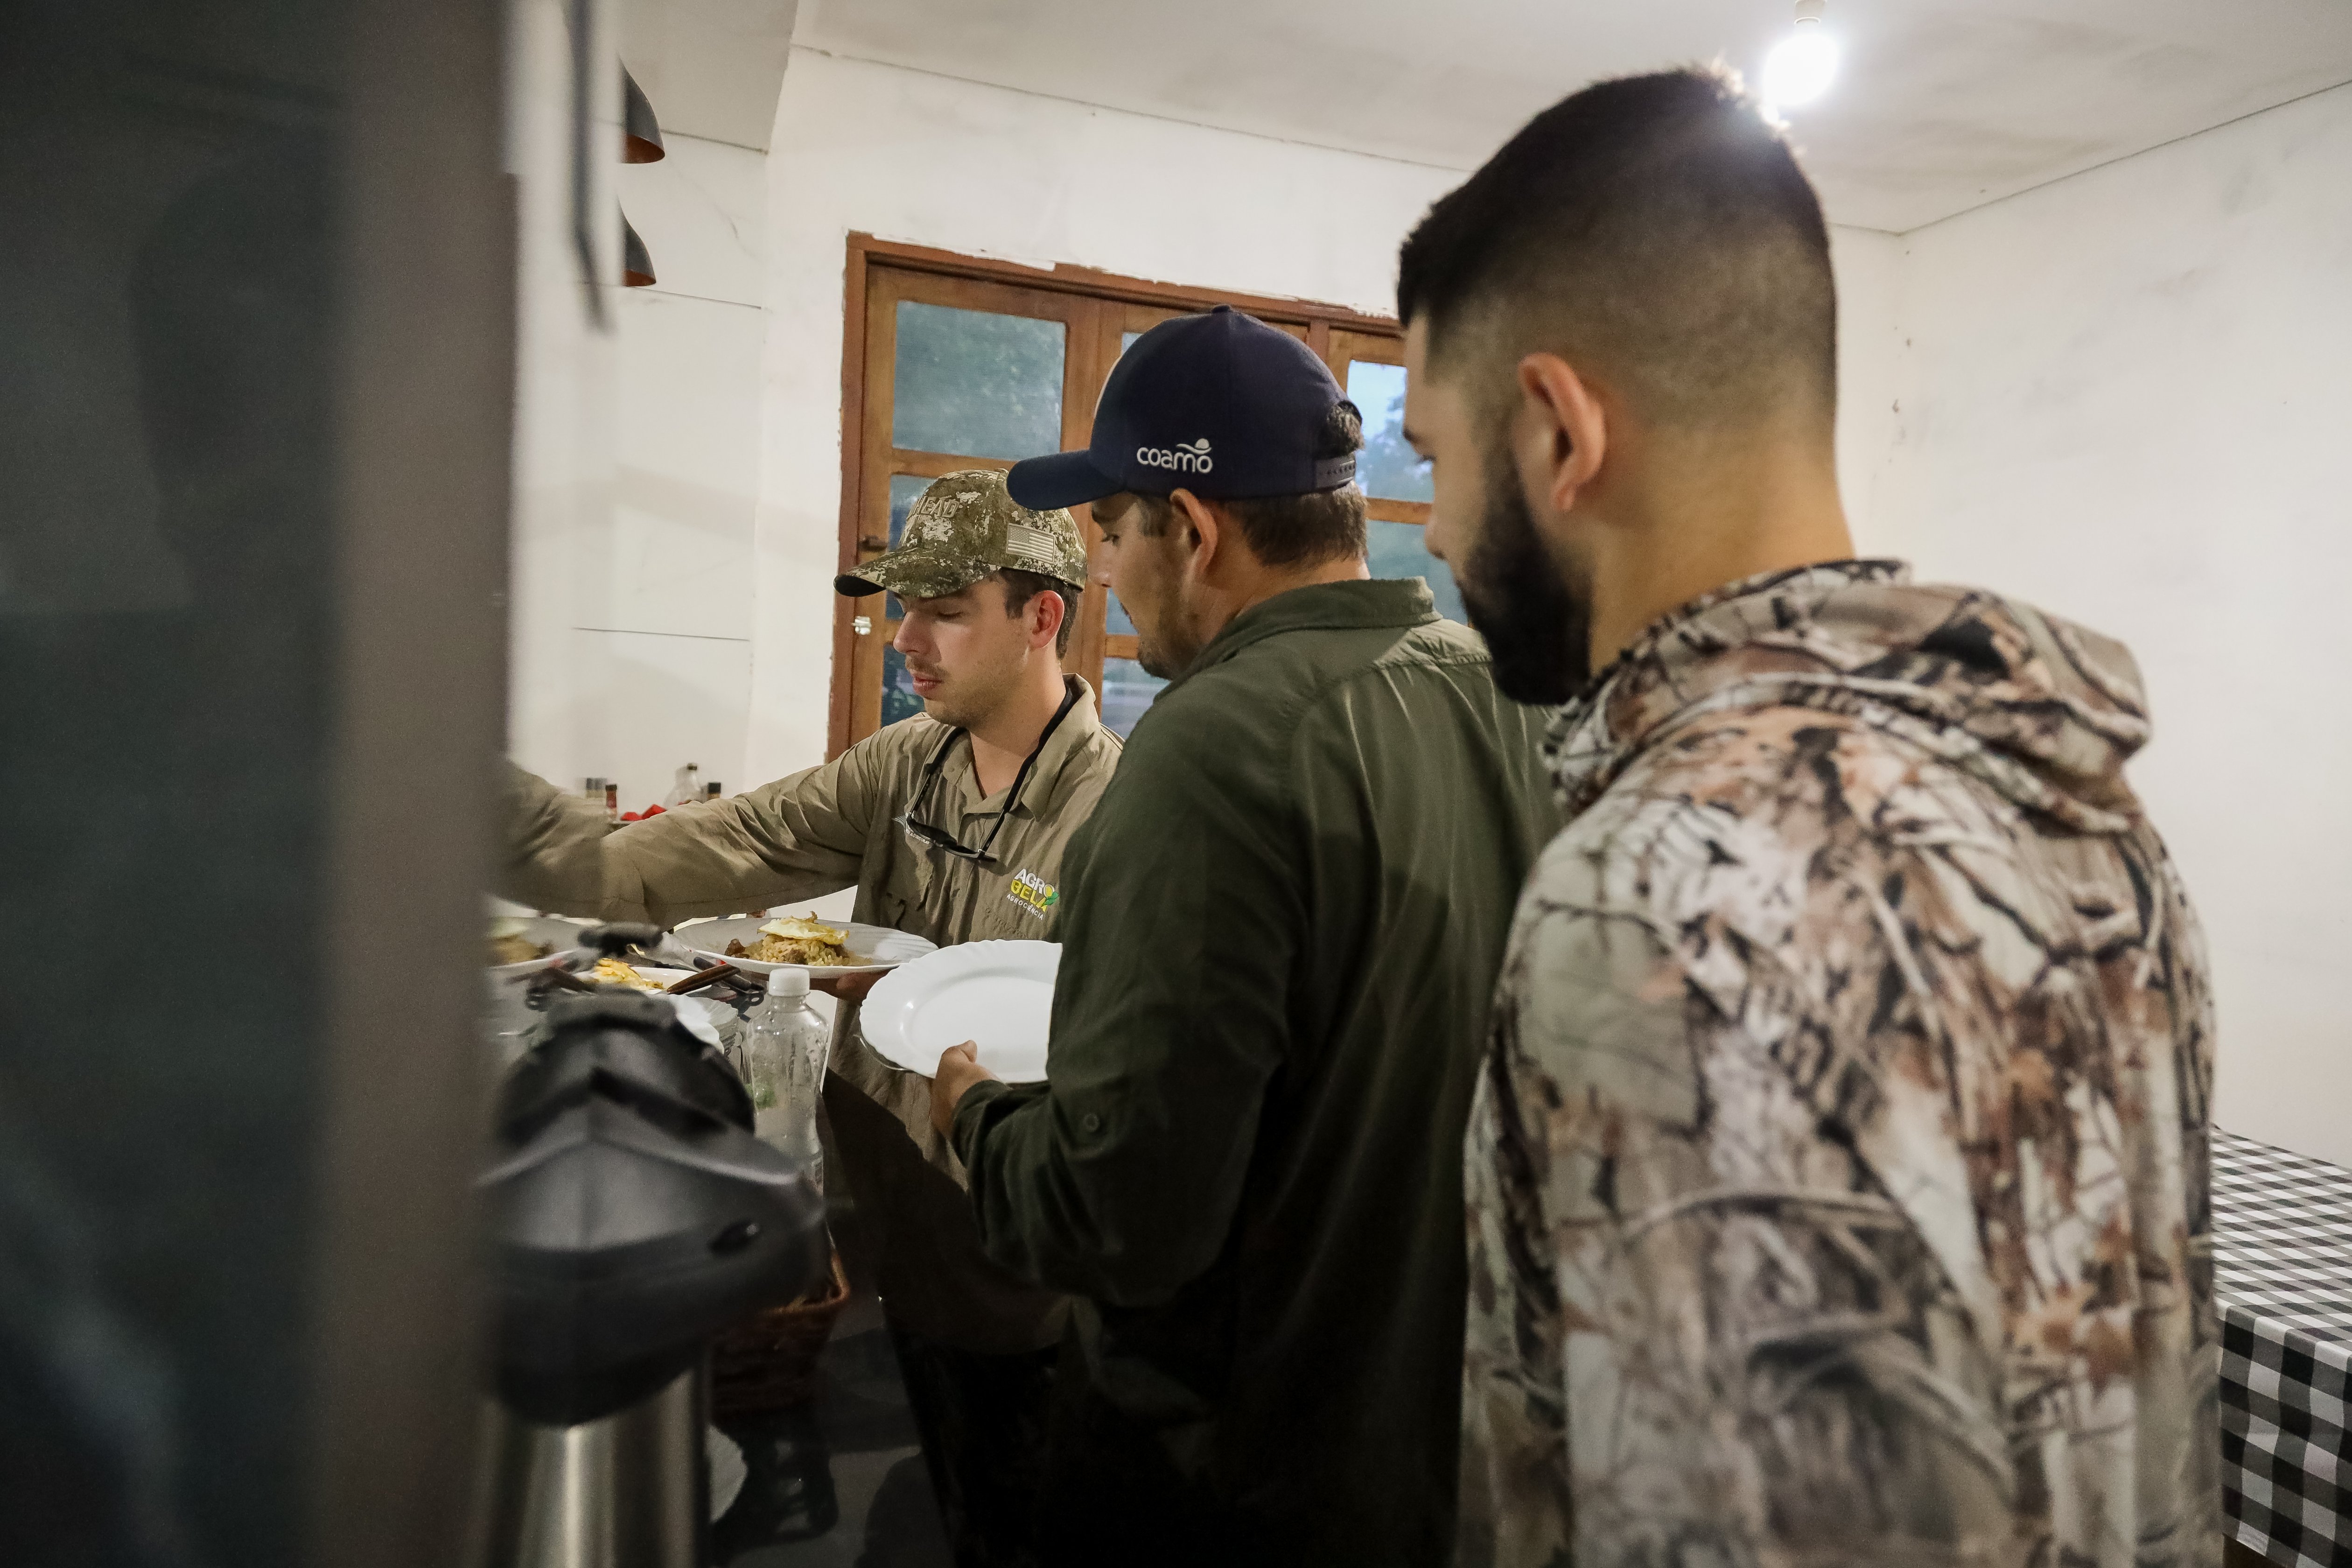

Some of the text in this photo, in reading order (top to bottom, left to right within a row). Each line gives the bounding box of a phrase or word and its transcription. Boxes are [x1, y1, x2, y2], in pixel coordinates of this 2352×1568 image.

[1136, 447, 1213, 474] coamo
[906, 496, 960, 519] HEAD
[1010, 879, 1048, 913] BELA
[1014, 868, 1055, 898] AGRO
[1006, 893, 1044, 921] AGROCIÊNCIA
